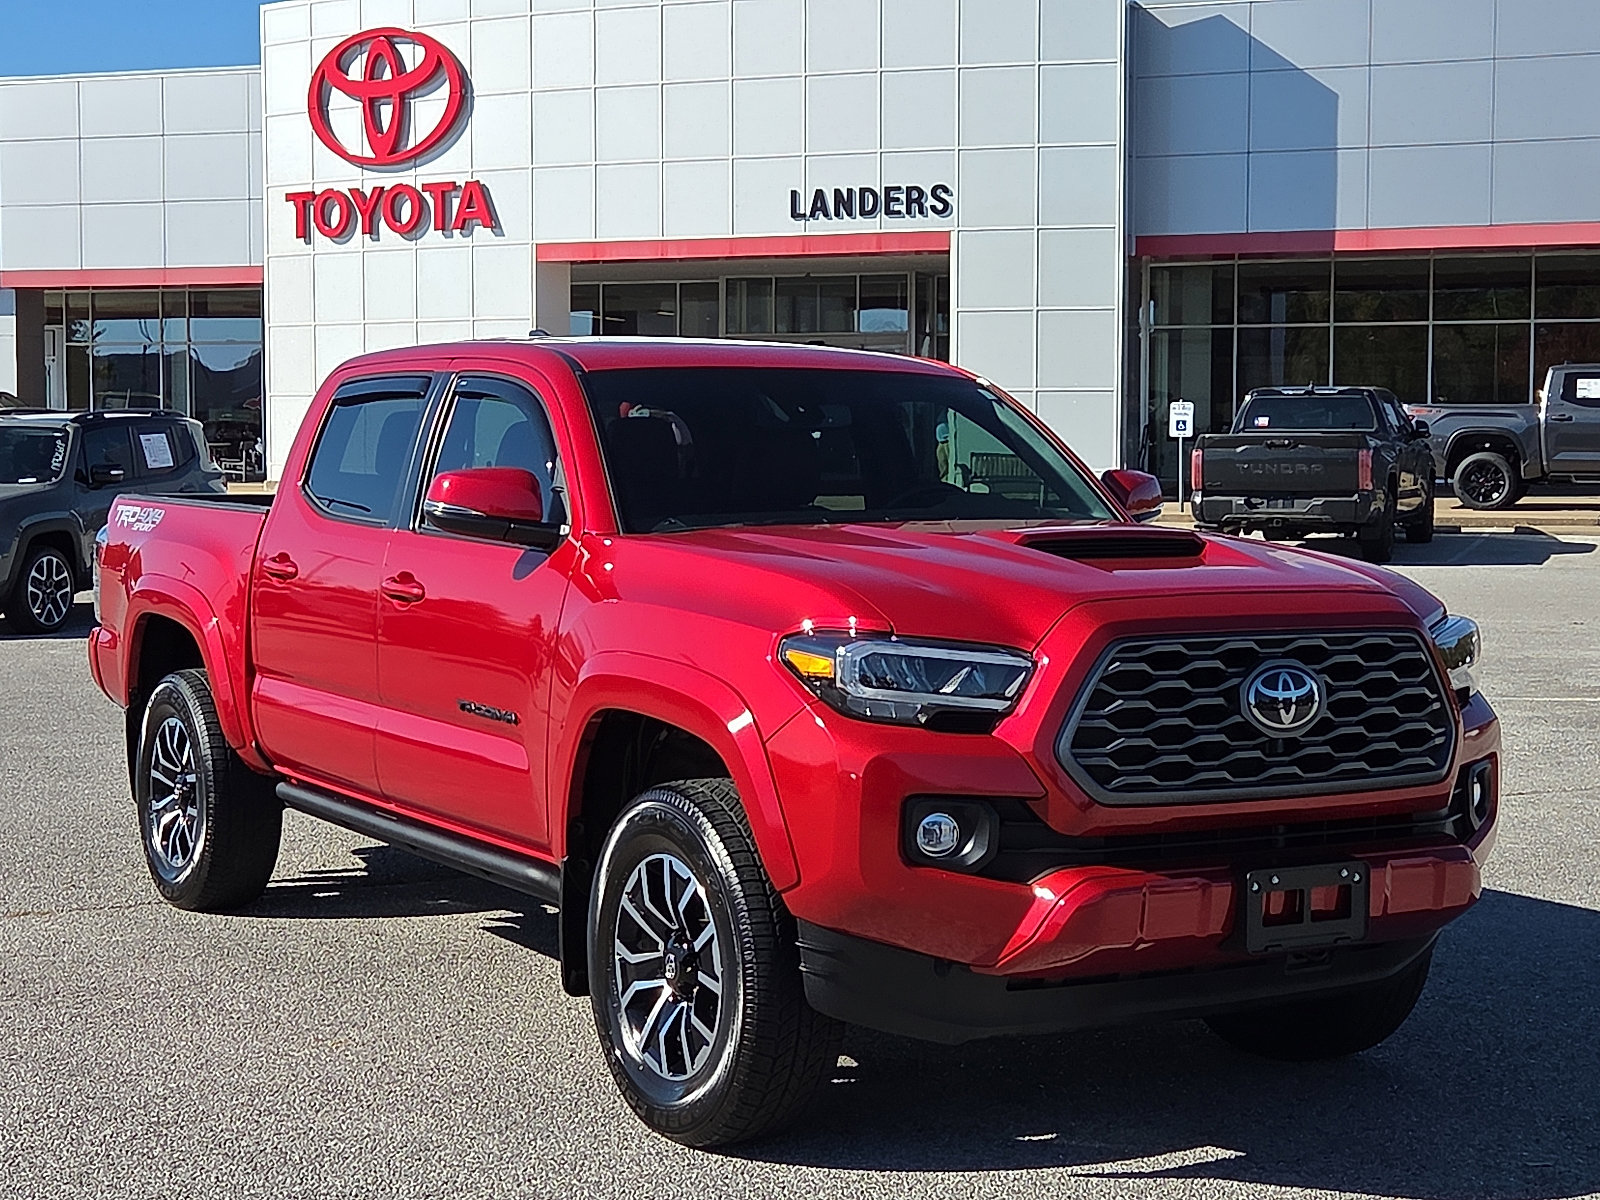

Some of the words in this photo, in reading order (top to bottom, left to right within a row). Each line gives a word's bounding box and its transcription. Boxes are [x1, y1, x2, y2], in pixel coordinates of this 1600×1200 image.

[285, 179, 499, 243] TOYOTA
[790, 184, 953, 219] LANDERS
[1235, 463, 1325, 475] TUNDRA
[115, 504, 142, 528] TRD
